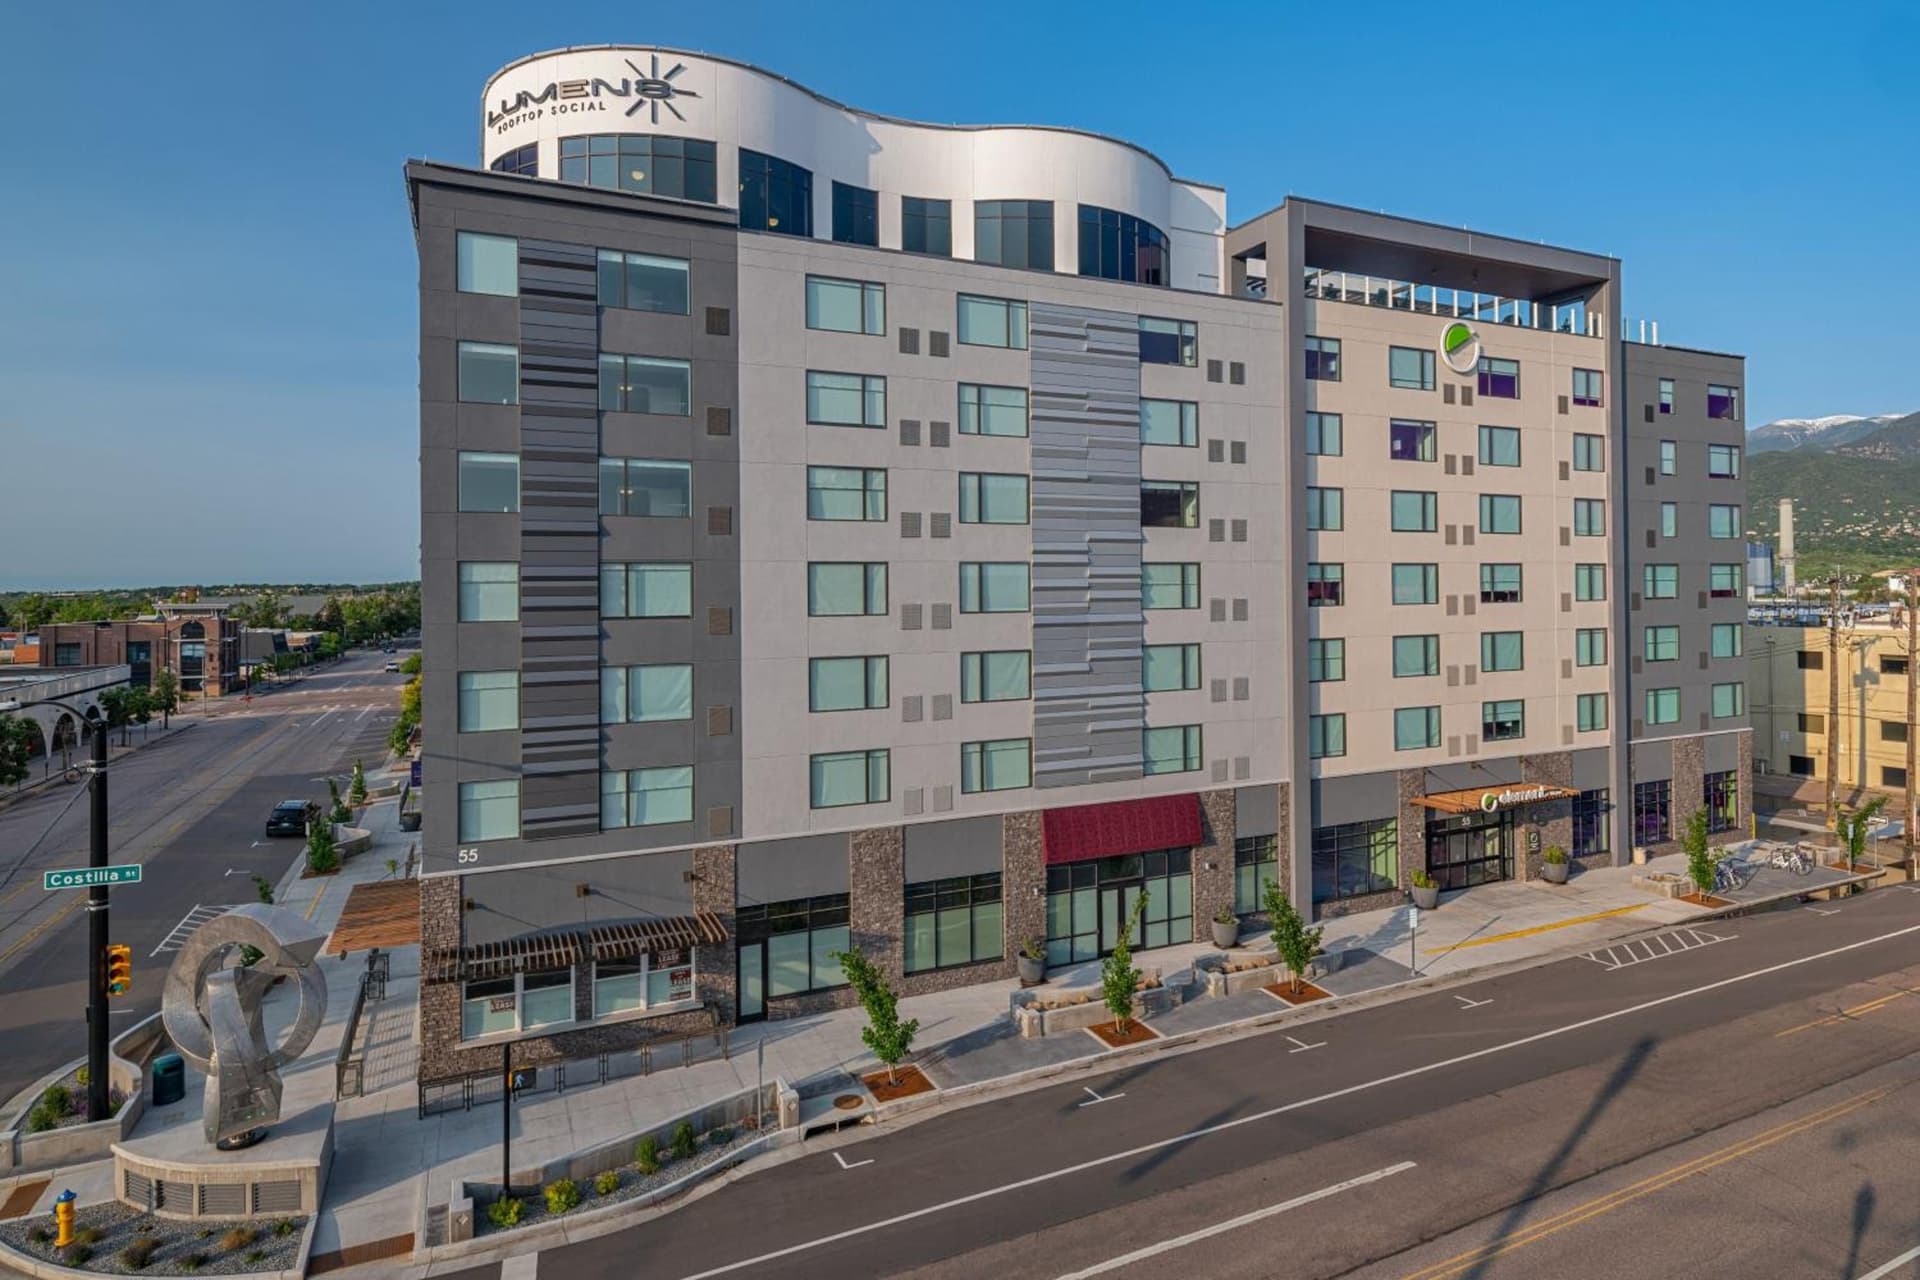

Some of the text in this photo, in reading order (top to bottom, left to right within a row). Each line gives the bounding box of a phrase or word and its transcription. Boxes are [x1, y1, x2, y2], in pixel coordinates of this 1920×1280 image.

[498, 101, 606, 135] ROOFTOP SOCIAL
[458, 848, 479, 864] 55
[50, 870, 119, 886] Costilla
